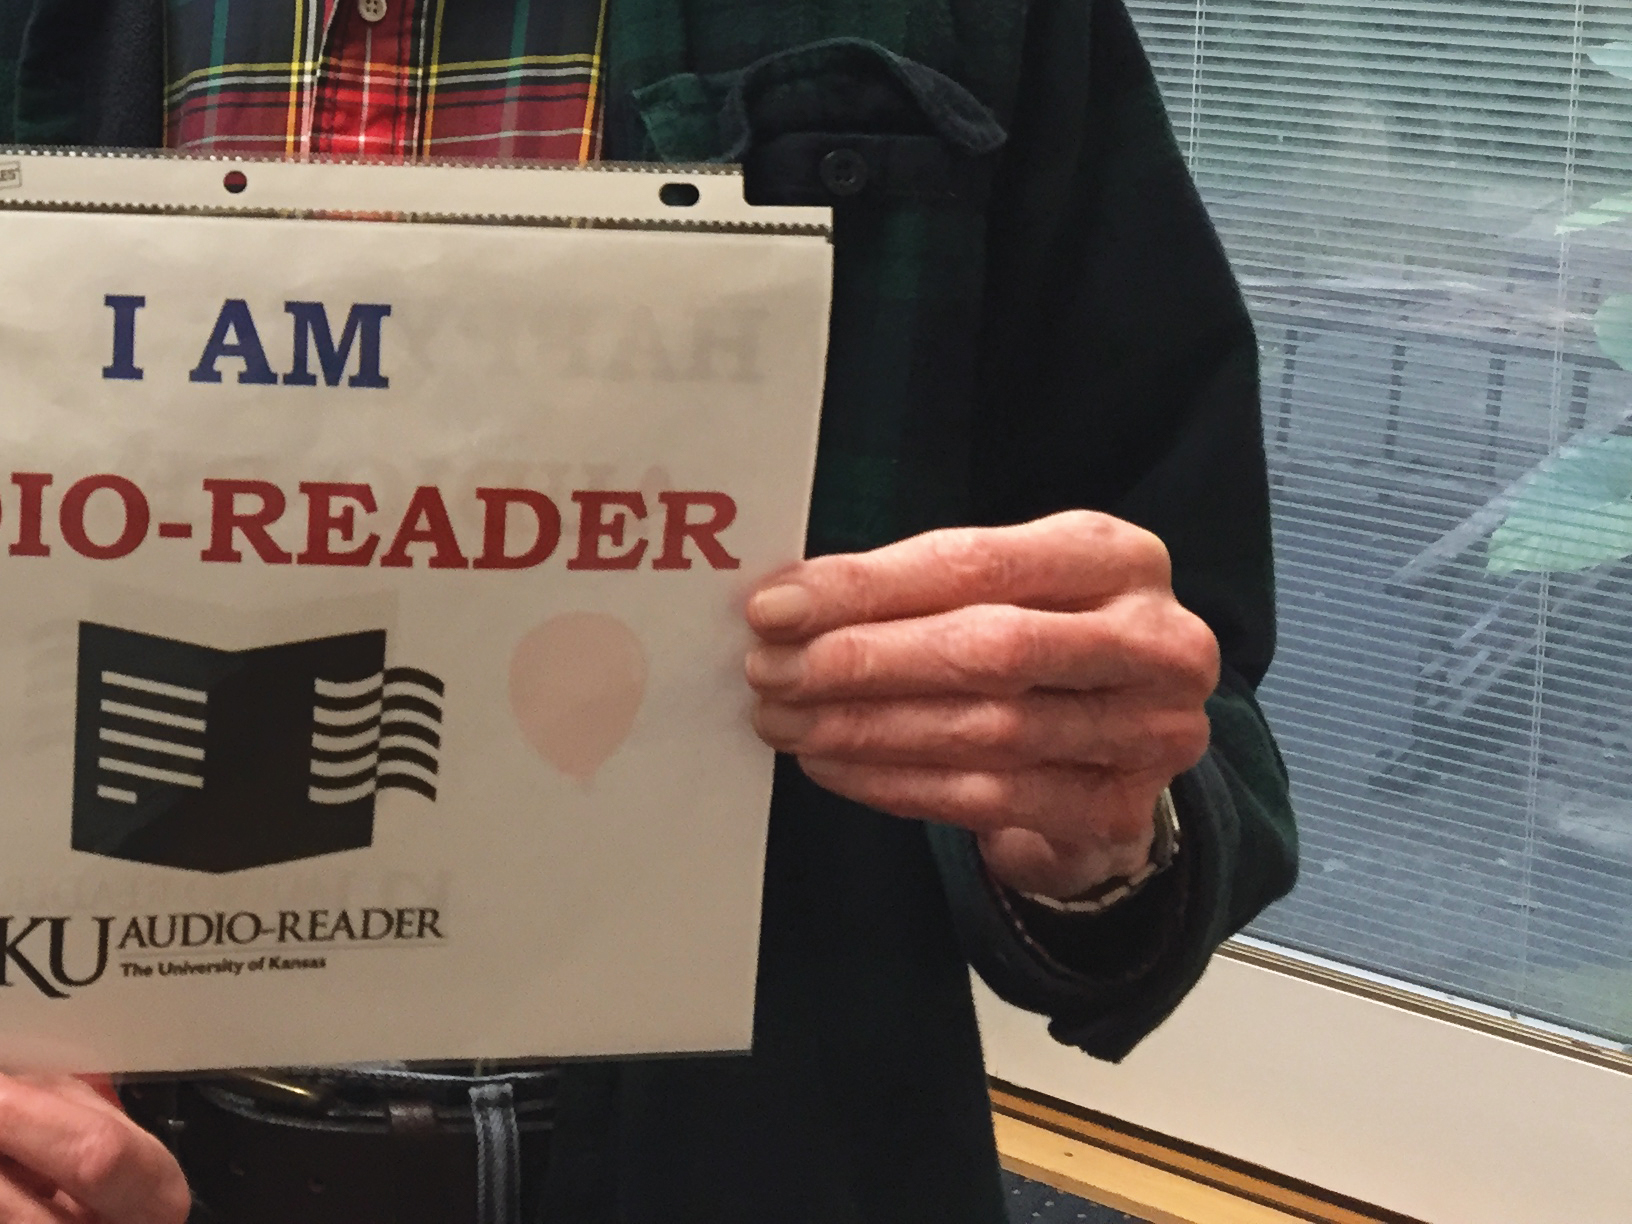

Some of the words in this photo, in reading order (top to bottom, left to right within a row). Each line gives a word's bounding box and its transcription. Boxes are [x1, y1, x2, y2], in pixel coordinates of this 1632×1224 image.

[102, 294, 146, 380] I
[189, 298, 392, 389] AM
[117, 907, 445, 950] AUDIO-READER
[120, 962, 154, 977] The
[158, 958, 245, 976] University
[247, 957, 266, 971] of
[269, 957, 327, 970] Kansas
